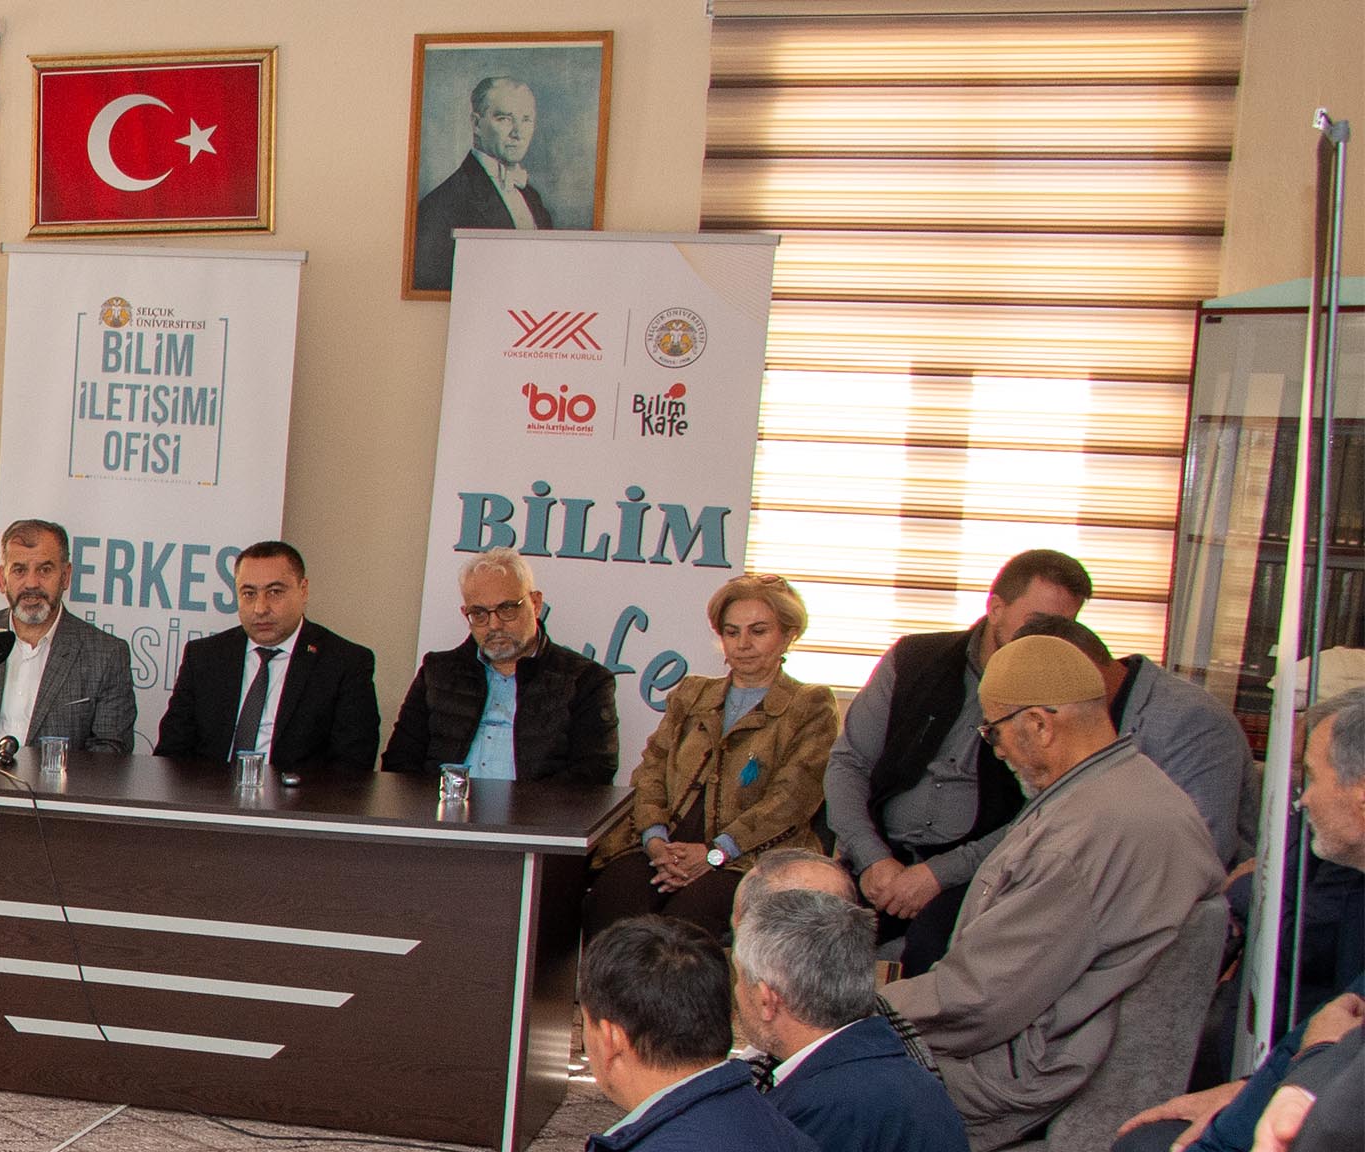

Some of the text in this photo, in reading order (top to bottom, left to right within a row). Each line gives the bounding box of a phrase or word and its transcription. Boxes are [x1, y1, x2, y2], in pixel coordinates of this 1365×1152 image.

[136, 306, 175, 319] SELÇUK
[136, 317, 206, 330] ÜNİVERSİTESİ
[101, 329, 195, 377] BİLİM
[502, 350, 603, 360] YÜKSEKÖĞRETİM KURULU
[78, 381, 218, 428] İLETİŞİMİ
[632, 393, 686, 416] Bilim
[641, 411, 688, 438] Kafe
[102, 430, 182, 475] OFİSİ
[453, 480, 733, 569] BİLİM
[69, 536, 239, 614] ERKES
